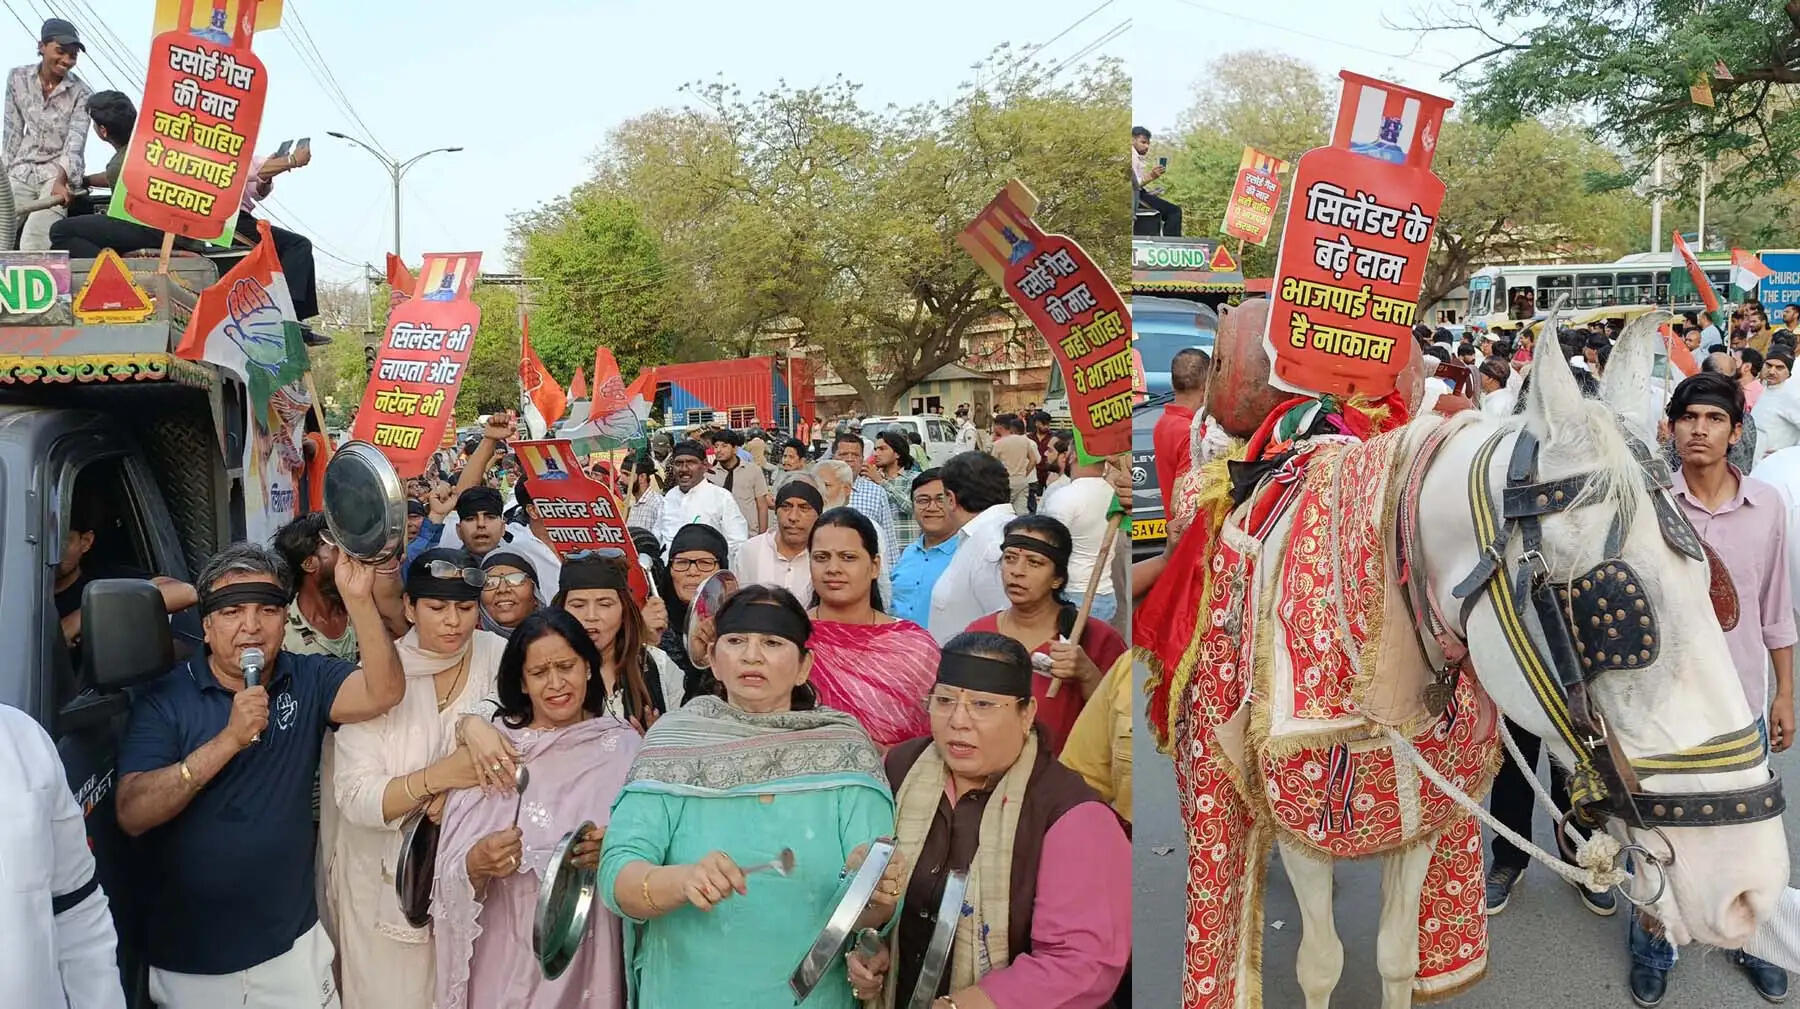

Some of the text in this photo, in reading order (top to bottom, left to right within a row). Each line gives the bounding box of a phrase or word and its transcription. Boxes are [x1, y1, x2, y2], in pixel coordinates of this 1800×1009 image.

[169, 45, 255, 90] रसोई गैस
[173, 78, 240, 120] की मार
[153, 110, 245, 156] नहीं चाहिए
[145, 139, 236, 189] ये भाजपाई
[147, 176, 216, 216] सरकार
[1306, 181, 1433, 244] सिलेंडर के
[1017, 248, 1079, 299] रसोई गैस
[1148, 248, 1204, 266] SOUND
[1314, 233, 1407, 285] बढ़े दाम
[1046, 283, 1096, 324] की मार
[1281, 277, 1418, 328] भाजपाई सत्ता
[1763, 290, 1779, 304] THE
[388, 322, 471, 351] सिलेंडर भी
[1059, 310, 1126, 360] नहीं चाहिए
[1289, 311, 1395, 363] है नाकाम
[378, 355, 460, 384] लापता और
[1073, 364, 1088, 394] ये
[374, 385, 445, 417] नरेन्द्र भी
[373, 423, 424, 450] लापता
[532, 497, 614, 519] सिलेंडर भी
[545, 521, 625, 543] लापता और
[1132, 523, 1168, 537] 5AV4
